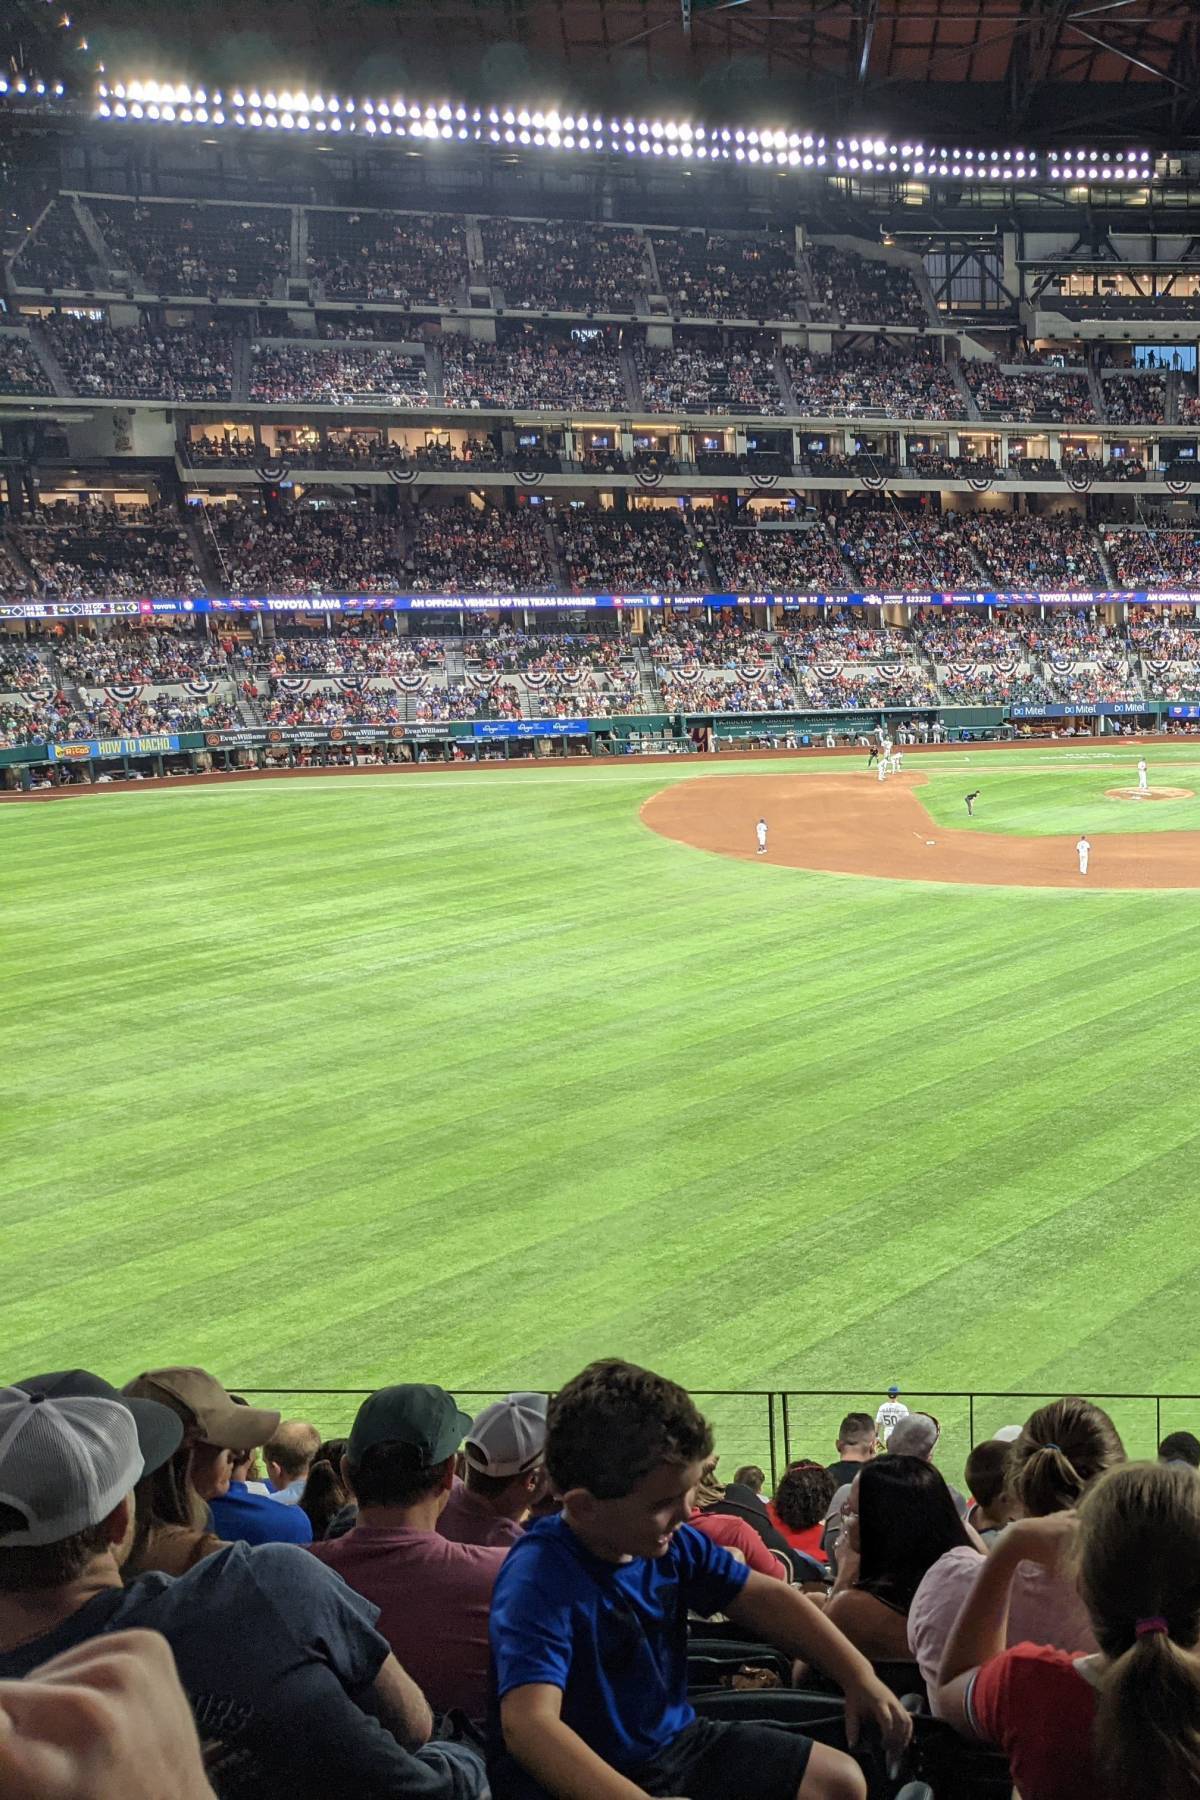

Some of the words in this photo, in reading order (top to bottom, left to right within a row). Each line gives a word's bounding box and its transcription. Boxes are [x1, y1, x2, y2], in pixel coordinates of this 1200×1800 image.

[411, 599, 424, 608] AN
[424, 598, 464, 608] OFFICIAL
[464, 598, 500, 607] VEHICLE
[500, 598, 512, 606] OF
[512, 598, 530, 606] THE
[530, 597, 556, 606] TEXAS
[556, 597, 596, 606] RANGERS
[738, 596, 750, 604] AVG
[1038, 594, 1070, 602] TOYOTA
[1072, 594, 1094, 602] RAV4
[268, 600, 311, 610] TOYOTA
[312, 600, 342, 610] RAV4
[1025, 706, 1047, 716] Mitel
[1075, 705, 1097, 714] Mitel
[1124, 703, 1146, 712] Mitel
[482, 726, 498, 734] Kroger
[518, 724, 534, 732] Kroger
[552, 722, 569, 731] Kroger
[98, 740, 122, 754] HOW
[124, 740, 136, 753] TO
[138, 738, 173, 752] NACHO.
[65, 747, 90, 756] Ricos
[883, 1415, 898, 1426] 50
